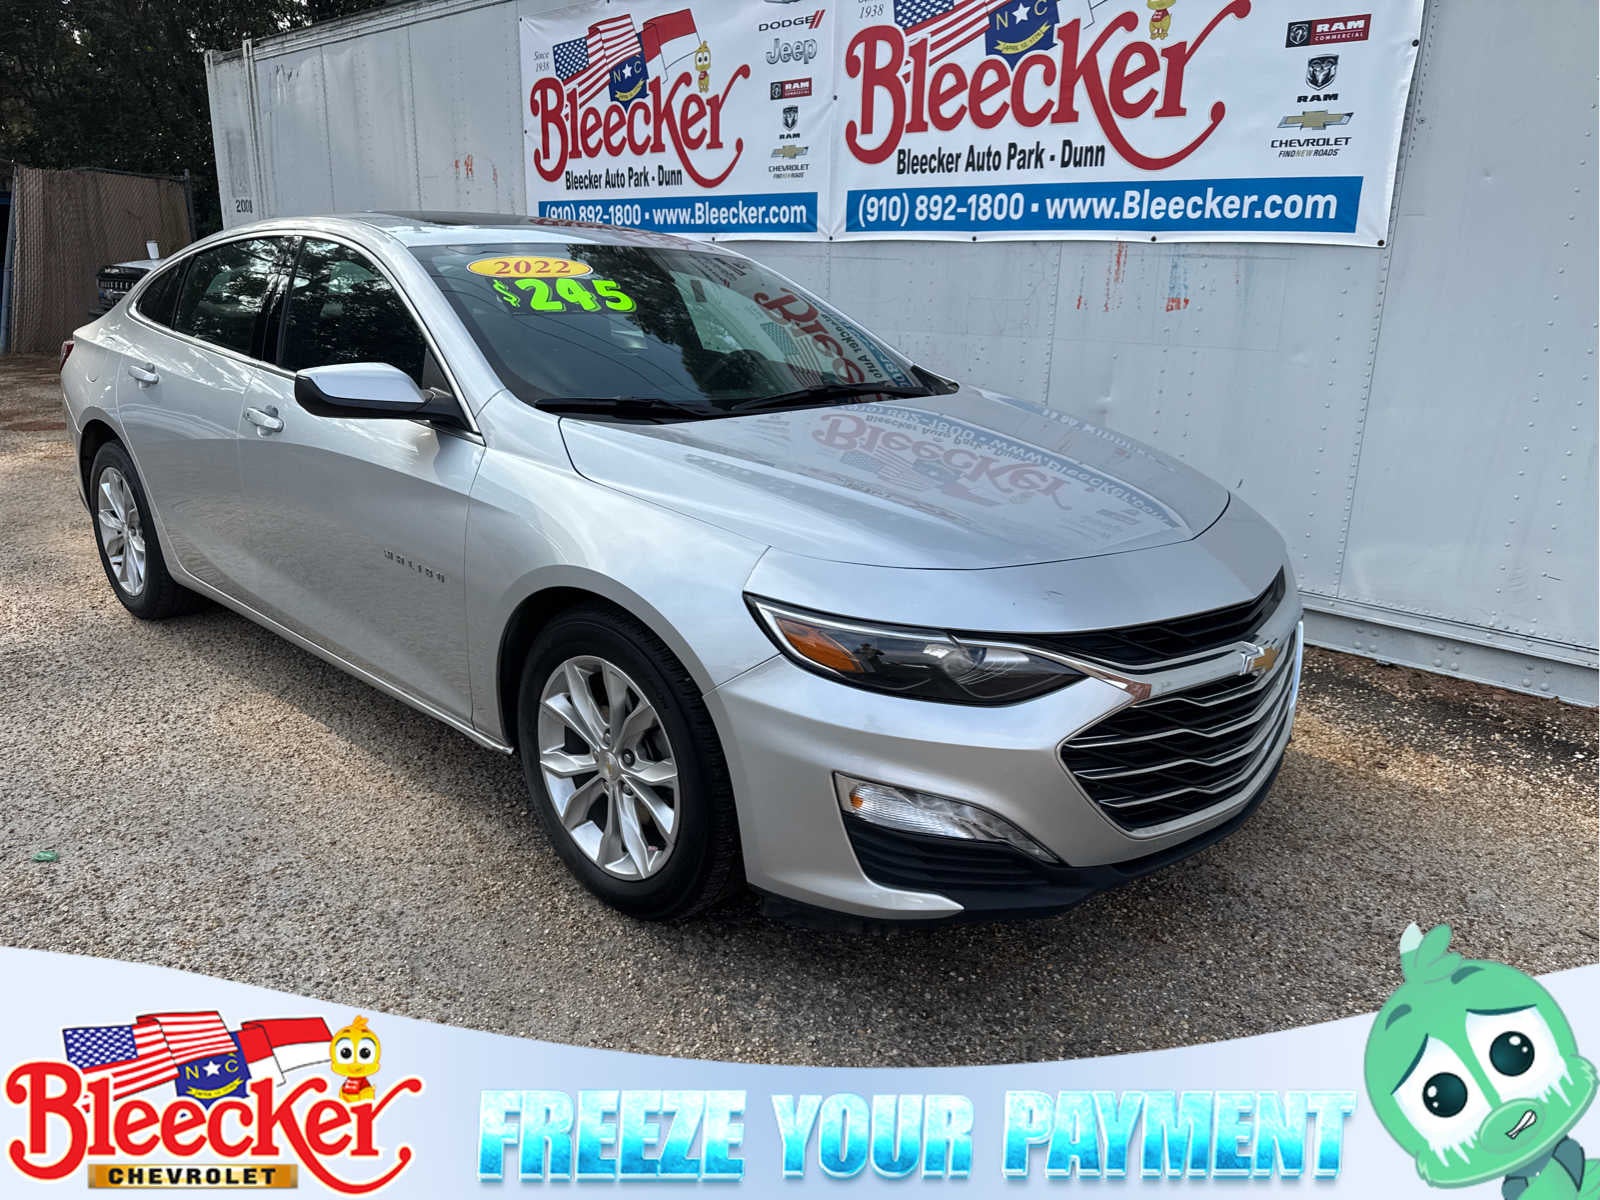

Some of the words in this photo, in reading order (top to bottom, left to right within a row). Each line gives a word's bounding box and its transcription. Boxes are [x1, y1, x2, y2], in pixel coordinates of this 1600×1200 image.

[859, 4, 885, 19] 1938
[758, 15, 815, 32] DODGE
[1316, 20, 1365, 32] RAM
[1314, 32, 1364, 41] COMMERCIAL
[766, 38, 818, 65] Jeep
[785, 82, 810, 90] RAM
[845, 0, 1252, 171] Bleecker
[1296, 93, 1339, 103] RAM
[530, 64, 751, 189] Bleecker
[779, 132, 801, 140] RAM
[1271, 137, 1352, 148] CHEVROLET
[896, 148, 962, 175] Bleecker
[965, 146, 1001, 172] Auto
[1005, 142, 1045, 168] Park
[1061, 138, 1105, 166] Dunn
[768, 164, 810, 173] CHEVROLET
[565, 169, 602, 190] Bleecker
[605, 168, 626, 188] Auto
[628, 166, 649, 187] Park
[658, 165, 682, 186] Dunn
[579, 204, 641, 226] 892-1800
[653, 200, 807, 226] www.Bleecker.com
[857, 193, 909, 228] (910)
[915, 192, 1025, 221] 892-1800
[1045, 189, 1337, 221] www.Bleecker.com
[494, 260, 571, 275] 2022
[492, 278, 637, 312] $245
